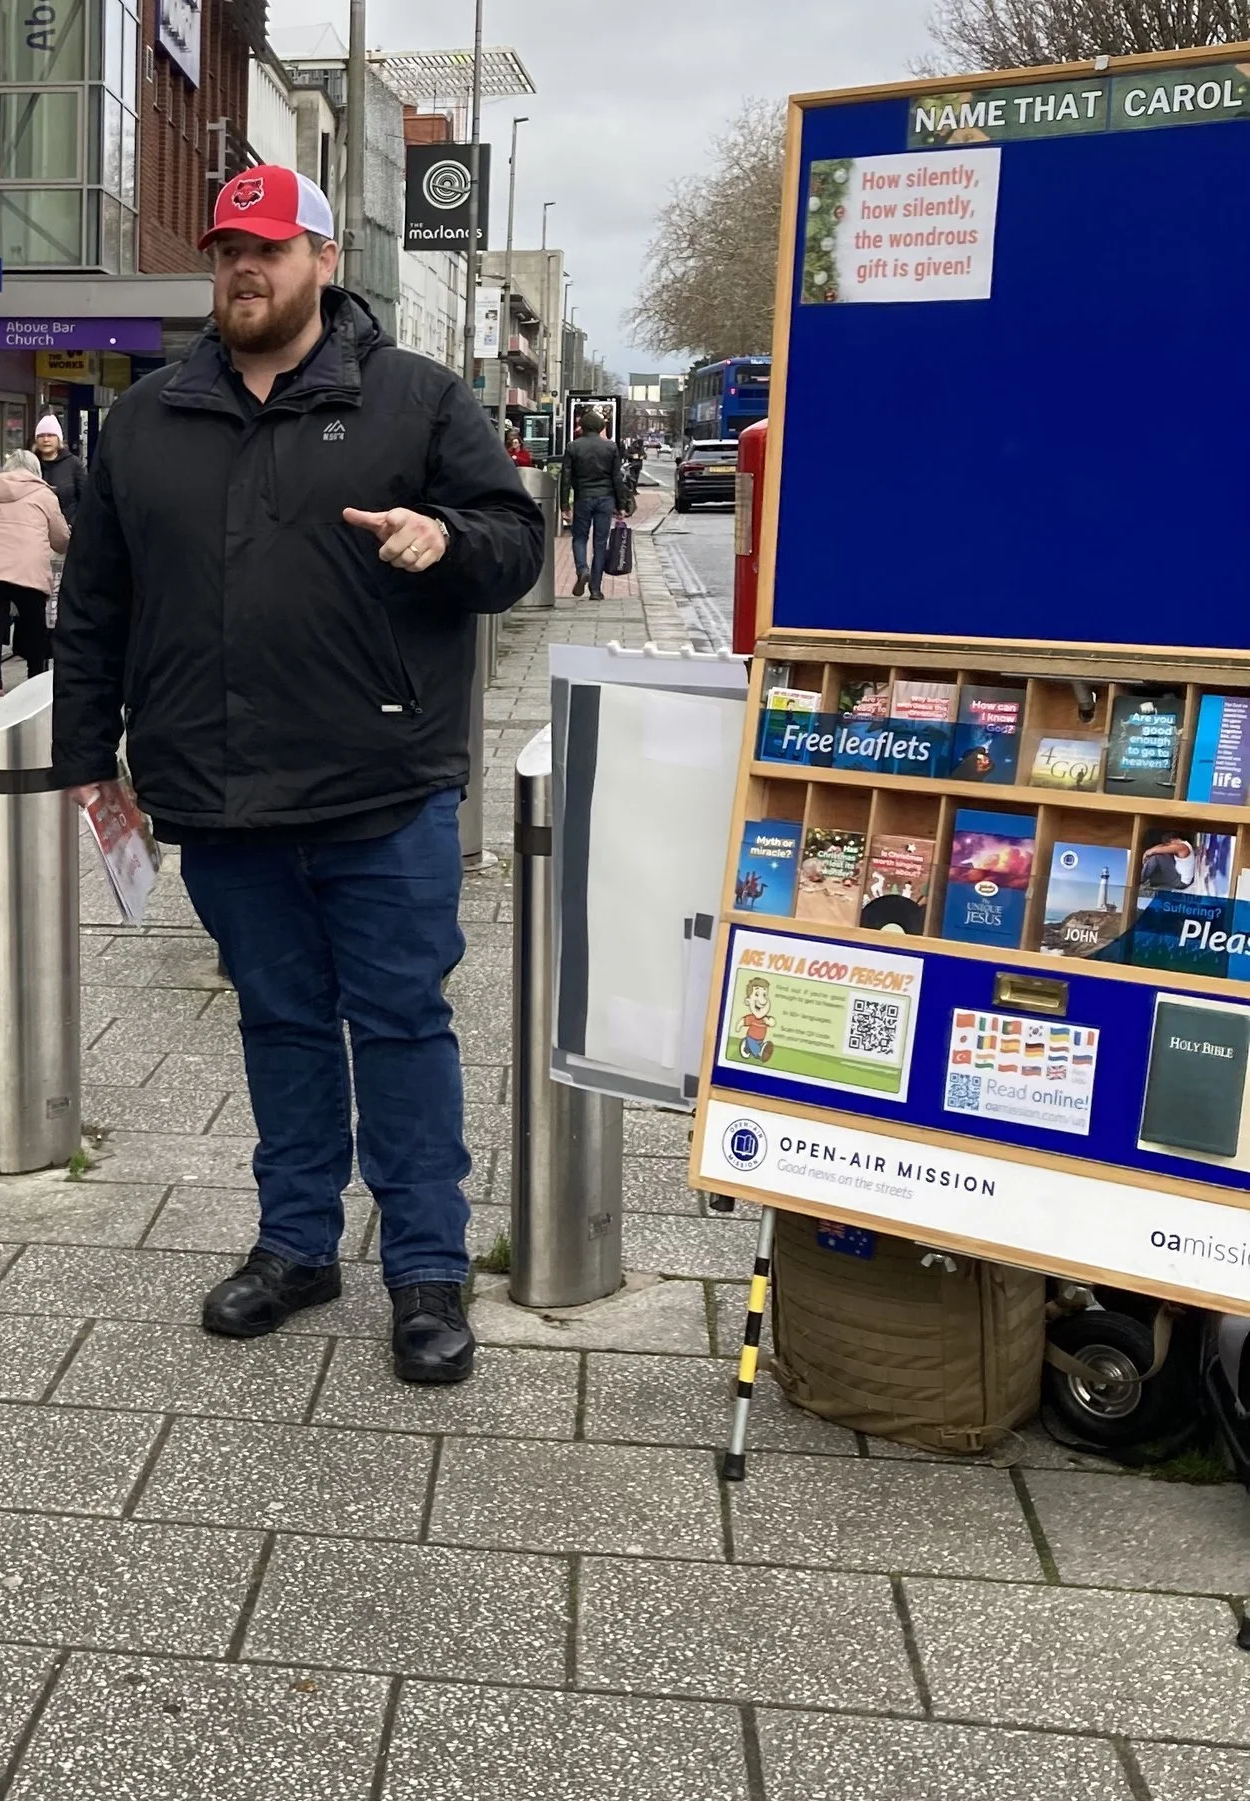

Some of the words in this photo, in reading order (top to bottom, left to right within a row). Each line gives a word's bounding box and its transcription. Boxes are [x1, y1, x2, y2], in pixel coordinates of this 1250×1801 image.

[915, 100, 1006, 133] NAME
[1013, 90, 1103, 124] THAT
[1123, 80, 1242, 118] CAROL
[861, 171, 901, 191] How
[905, 165, 980, 190] silently,
[860, 200, 898, 220] how
[902, 196, 975, 220] silently,
[854, 230, 884, 250] the
[888, 227, 979, 249] wondrous
[856, 259, 888, 284] gift
[892, 258, 909, 277] is
[914, 256, 972, 282] given!
[6, 321, 49, 333] Above
[52, 321, 77, 333] Bar
[6, 334, 54, 346] Church
[49, 360, 84, 369] WORKS
[972, 701, 996, 711] How
[997, 704, 1017, 712] can
[987, 713, 1015, 723] know
[1132, 712, 1151, 722] Are
[1153, 716, 1174, 725] you
[986, 723, 1016, 734] God?
[1141, 725, 1172, 736] good
[782, 724, 834, 753] Free
[837, 728, 931, 761] leaflets
[1129, 735, 1171, 747] enough
[1040, 744, 1056, 765] 4
[1127, 746, 1140, 755] to
[1141, 748, 1155, 758] go
[1157, 748, 1170, 757] to
[1122, 756, 1169, 768] heaven?
[1212, 771, 1242, 789] life
[756, 835, 781, 847] Myth
[782, 840, 794, 848] or
[842, 845, 859, 854] Has
[750, 847, 792, 859] miracle?
[964, 911, 1002, 926] JESUS
[1163, 901, 1222, 920] Suffering?
[1064, 928, 1099, 944] JOHN
[739, 949, 765, 967] ARE
[767, 953, 795, 972] YOU
[794, 958, 805, 974] A
[807, 960, 848, 980] GOOD
[849, 966, 914, 992] PERSON?
[1169, 1036, 1202, 1053] HOLY
[1202, 1041, 1234, 1059] BIBLE
[986, 1078, 1028, 1101] Read
[1031, 1089, 1090, 1111] online!
[780, 1136, 886, 1173] OPEN-AIR
[897, 1161, 996, 1197] MISSION
[777, 1158, 807, 1176] Good
[807, 1167, 837, 1183] news
[837, 1174, 853, 1186] on
[854, 1175, 873, 1191] the
[874, 1182, 914, 1200] streets
[1150, 1230, 1250, 1266] oamissi
